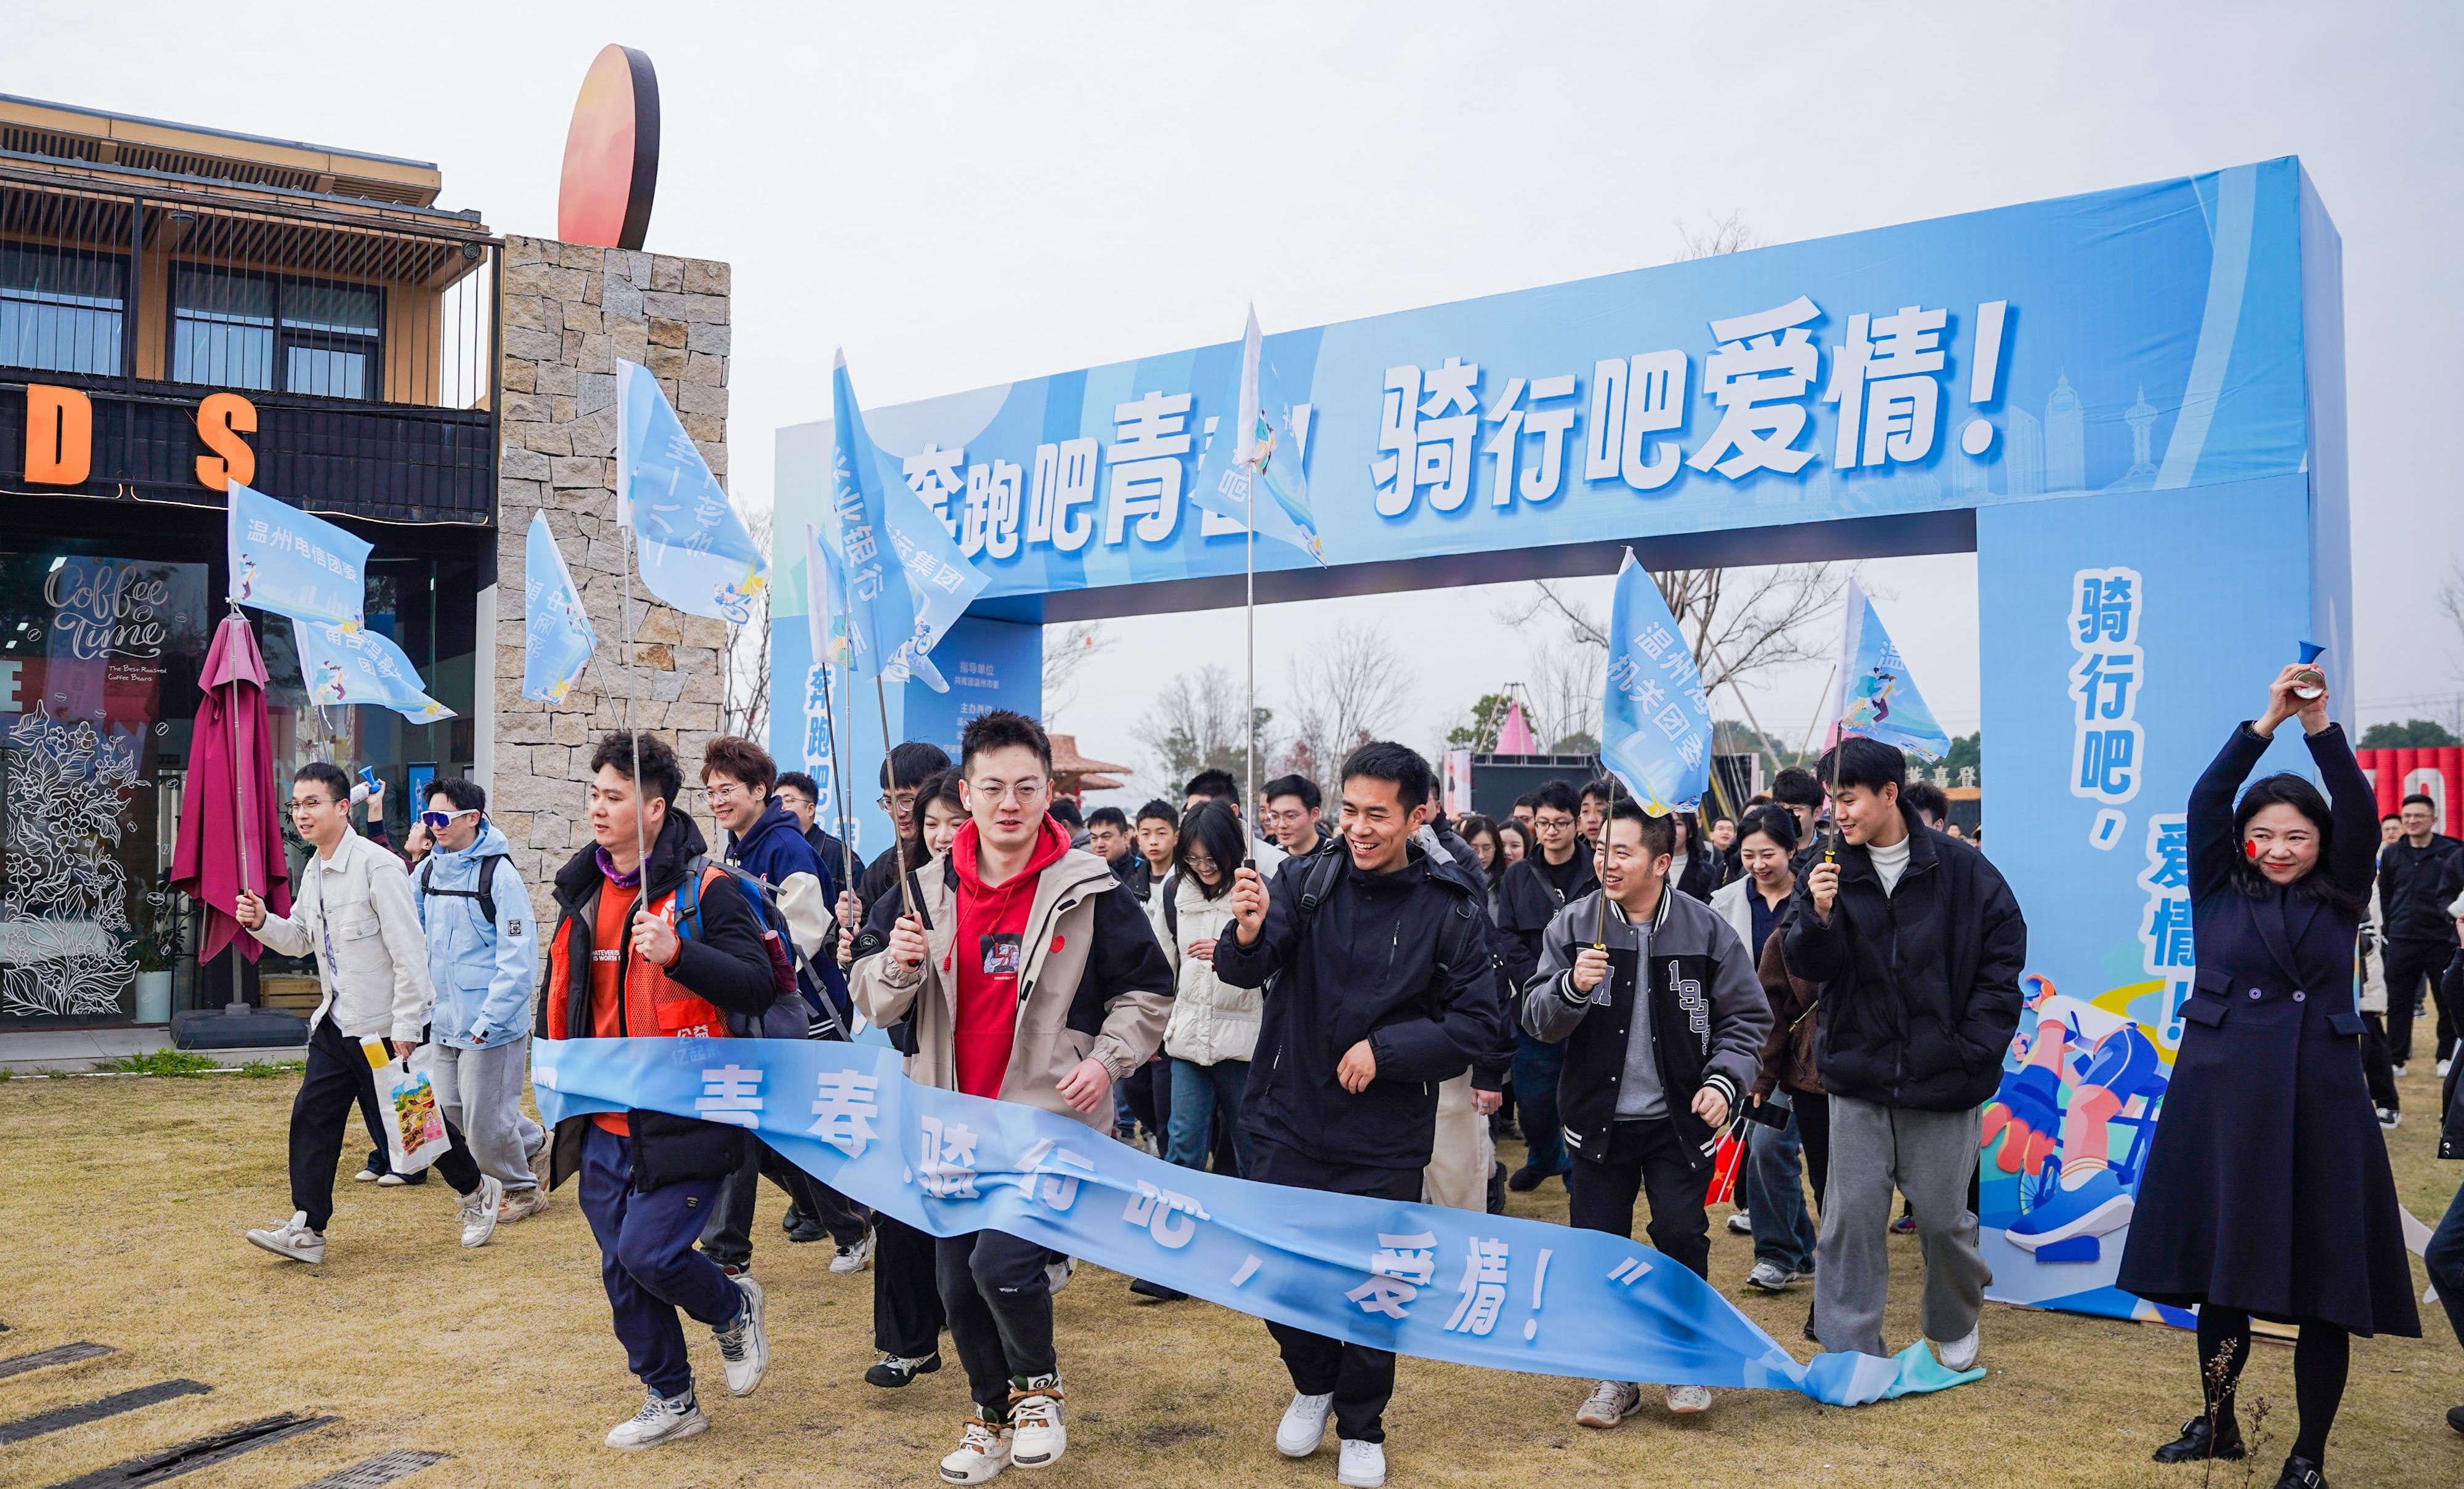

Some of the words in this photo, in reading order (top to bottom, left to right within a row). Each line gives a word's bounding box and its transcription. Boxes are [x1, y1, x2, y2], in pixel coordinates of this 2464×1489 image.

[1371, 295, 2008, 517] 骑行吧爱情！
[246, 519, 358, 584] 温州电信团委
[44, 565, 168, 619] Coffee
[54, 612, 166, 660] Time
[131, 674, 153, 682] Beans
[960, 661, 994, 676] 指导单位
[1607, 653, 1704, 772] 机关团委
[2078, 578, 2134, 841] 骑行吧，
